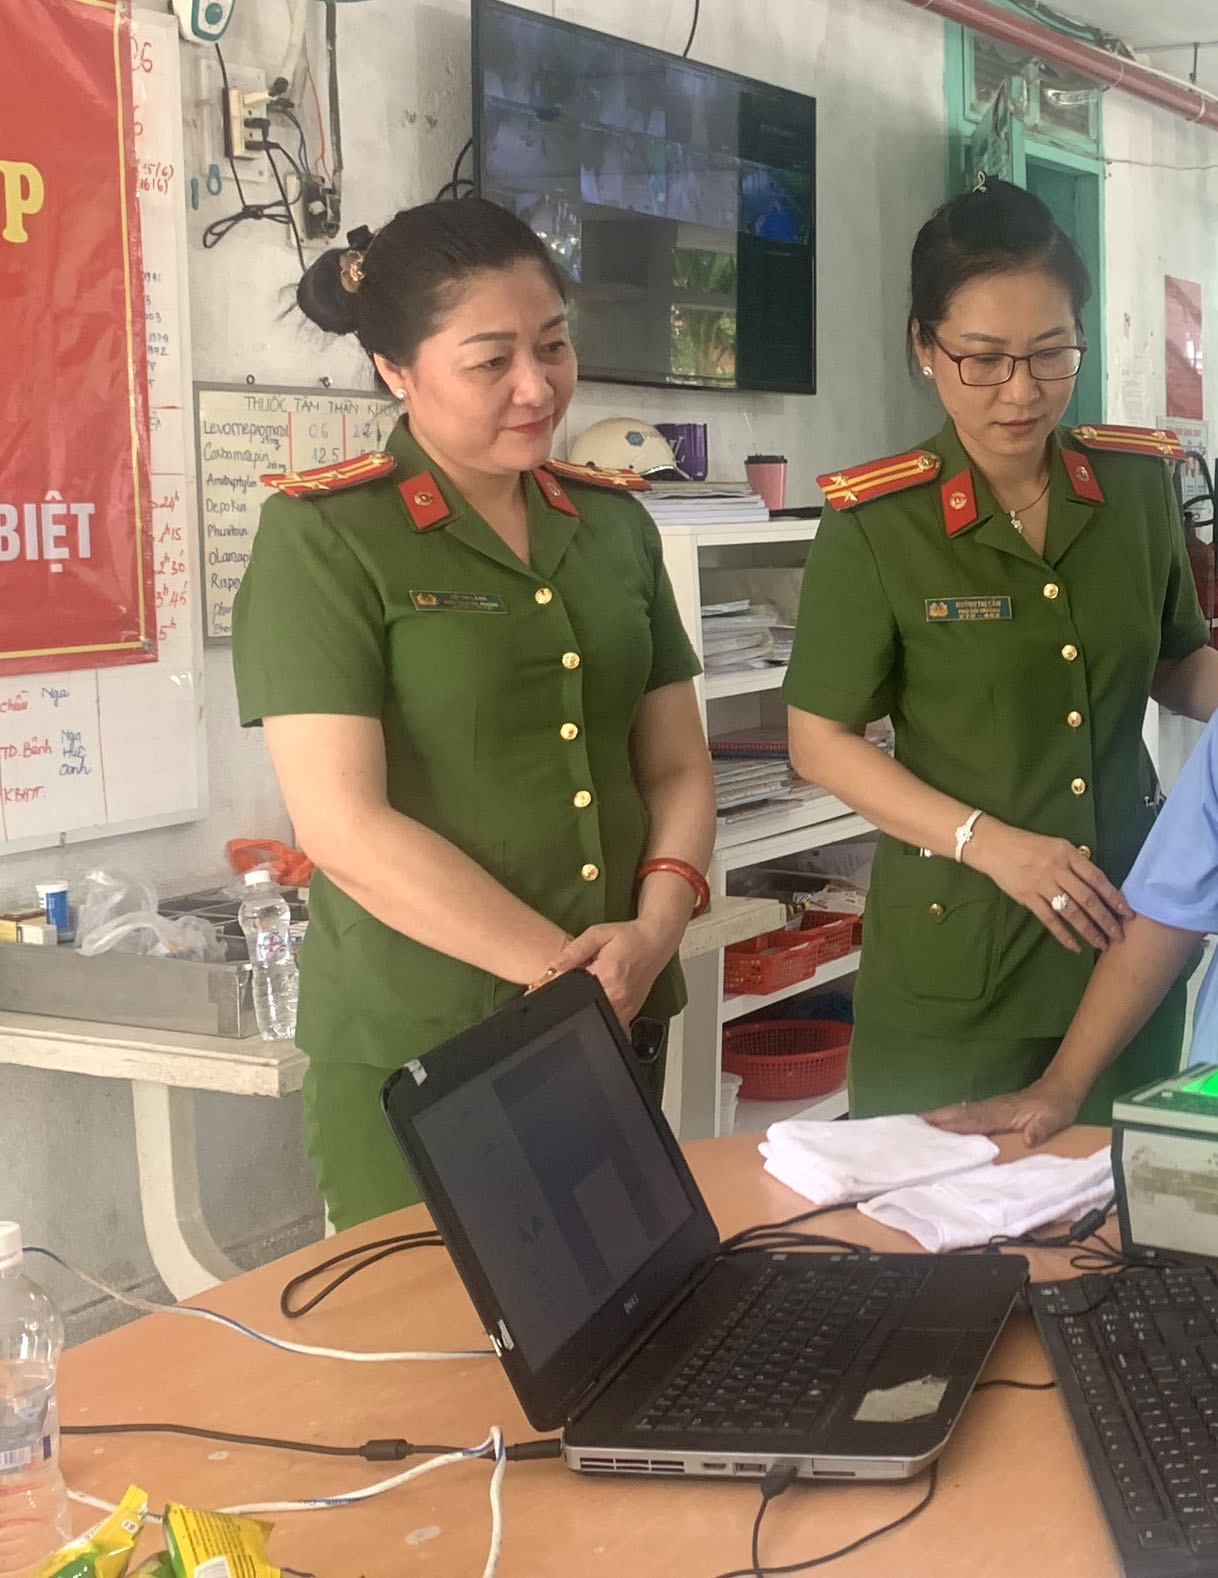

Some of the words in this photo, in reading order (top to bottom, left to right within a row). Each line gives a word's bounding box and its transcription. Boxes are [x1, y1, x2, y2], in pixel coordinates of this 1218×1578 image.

[0, 159, 45, 243] P
[0, 489, 96, 573] BIỆT
[41, 687, 70, 708] Nga
